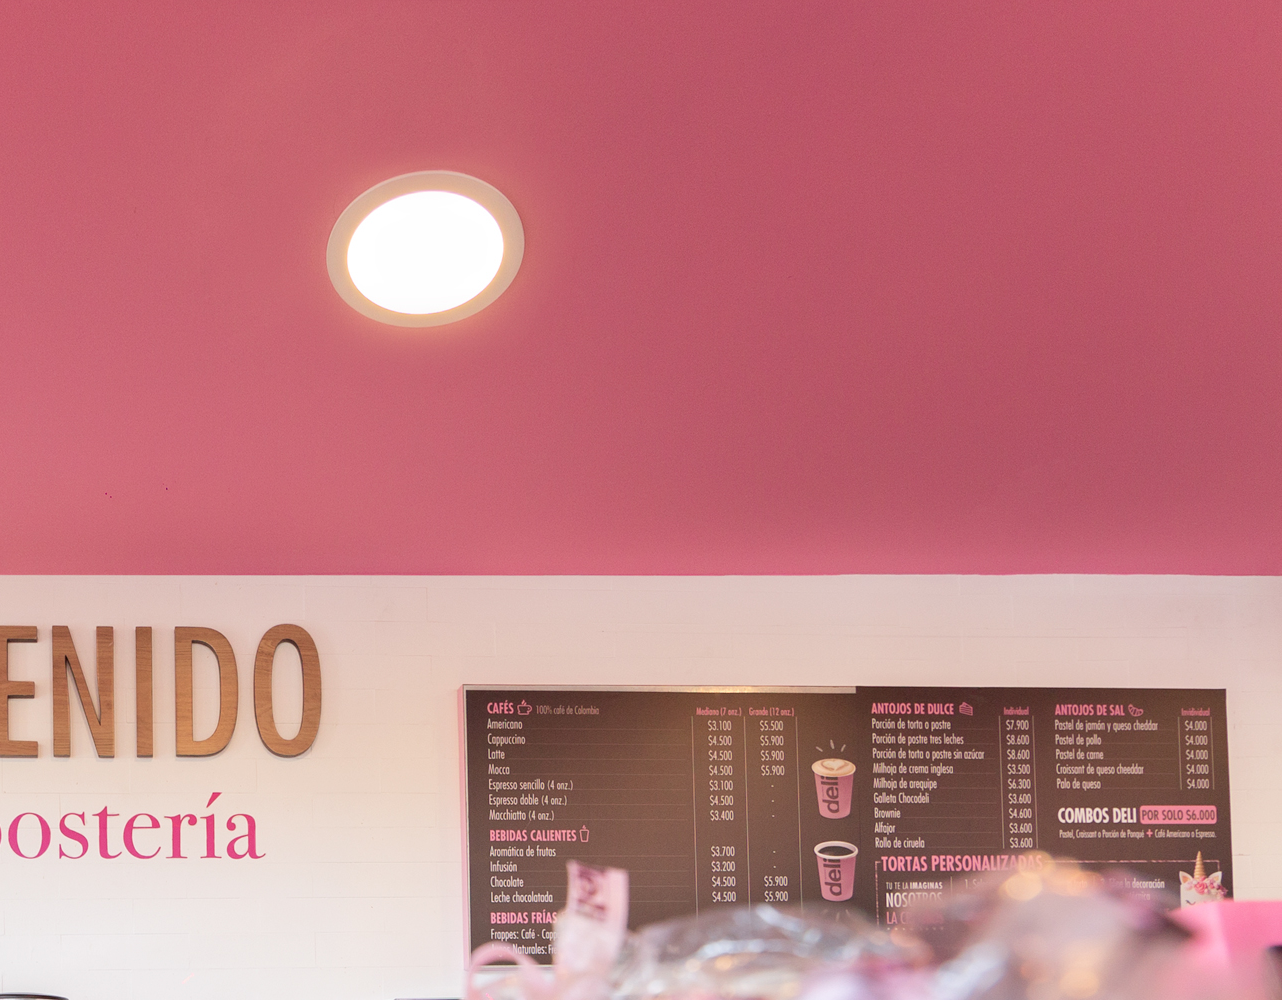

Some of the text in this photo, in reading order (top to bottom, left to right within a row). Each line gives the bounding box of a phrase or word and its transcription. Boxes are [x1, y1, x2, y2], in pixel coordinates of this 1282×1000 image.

[487, 700, 514, 714] CAFÉS
[536, 705, 599, 715] 100% café de Colombia
[769, 707, 779, 716] (12
[871, 703, 954, 714] ANTOJOS DE DULCE
[1055, 704, 1125, 716] ANTOJOS DE SAL
[487, 718, 523, 729] Americano
[708, 720, 732, 731] $3.100
[760, 720, 784, 731] $5.500
[872, 718, 951, 731] Porción de torta postre
[1006, 720, 1029, 730] $7.900
[1055, 719, 1158, 732] Pastel de jamón queso cheddar
[1185, 720, 1207, 730] $4.000
[488, 733, 526, 746] Cappuccino
[708, 735, 732, 746] $4.500
[760, 735, 784, 746] $5.900
[872, 733, 964, 746] Porción de postre tres leches
[1006, 734, 1030, 745] $8.600
[1055, 734, 1101, 747] Pastel de pollo
[1185, 735, 1208, 745] $4.000
[488, 749, 505, 759] Latte
[708, 750, 733, 761] $4.500
[760, 750, 784, 761] $5.900
[872, 748, 985, 761] Porción de torta postre sin azúcar
[1007, 749, 1030, 760] $8.600
[1056, 748, 1104, 760] Pastel de carne
[1186, 749, 1208, 760] $4.000
[488, 764, 510, 775] Mocca
[708, 765, 733, 776] $4.500
[761, 765, 785, 776] $5.900
[873, 763, 954, 776] Milhoja de crema inglesa
[1007, 764, 1030, 774] $3.500
[1056, 763, 1085, 774] Croissant
[1087, 763, 1094, 774] de
[1096, 767, 1115, 776] queso
[1186, 764, 1209, 774] $4.000
[488, 779, 573, 792] Espresso sencillo (4 onz.)
[709, 780, 733, 791] $3.100
[873, 777, 938, 791] Milhoja de arequipe
[1008, 779, 1031, 789] $6.300
[1057, 778, 1101, 791] Palo de queso
[1187, 778, 1210, 789] $4.000
[820, 775, 840, 814] deli
[874, 792, 930, 803] Galleta Chocodeli
[1008, 793, 1031, 804] $3.600
[489, 794, 567, 807] Espresso doble (4 onz.)
[710, 795, 734, 806] $4.500
[489, 809, 554, 821] Macchiatto (4 onz.)
[710, 810, 734, 821] $3.400
[874, 807, 901, 818] Brownie
[1009, 808, 1032, 819] $4.600
[1057, 807, 1216, 824] COMBOS DELI POR SOLO $6.000
[874, 822, 895, 835] Alfajor
[1009, 823, 1032, 834] $3.600
[1076, 830, 1097, 838] Croissant
[1102, 830, 1119, 838] Porción
[1155, 829, 1166, 838] Café
[1166, 829, 1190, 838] Americano
[489, 829, 577, 842] BEBIDAS CALIENTES
[875, 837, 925, 848] Rollo de ciruela
[1010, 837, 1033, 848] $3.600
[489, 845, 556, 857] Aromática de frutas
[711, 846, 735, 857] $3.700
[490, 861, 517, 872] Infusión
[711, 861, 735, 872] $3.200
[881, 855, 1042, 872] TORTAS PERSONALIZADAS
[490, 876, 524, 887] Chocolate
[712, 876, 736, 887] $4.500
[764, 876, 788, 887] $5.900
[823, 858, 843, 897] deli
[1132, 878, 1165, 888] decoración
[886, 882, 943, 890] TU TE LA IMAGINAS
[491, 891, 553, 903] Leche chocolatada
[712, 891, 736, 902] $4.500
[764, 891, 789, 902] $5.900
[490, 909, 557, 924] BEBIDAS FRÍAS
[886, 911, 897, 924] LA
[491, 928, 535, 941] Frappes: Café
[512, 943, 547, 955] Naturales:
